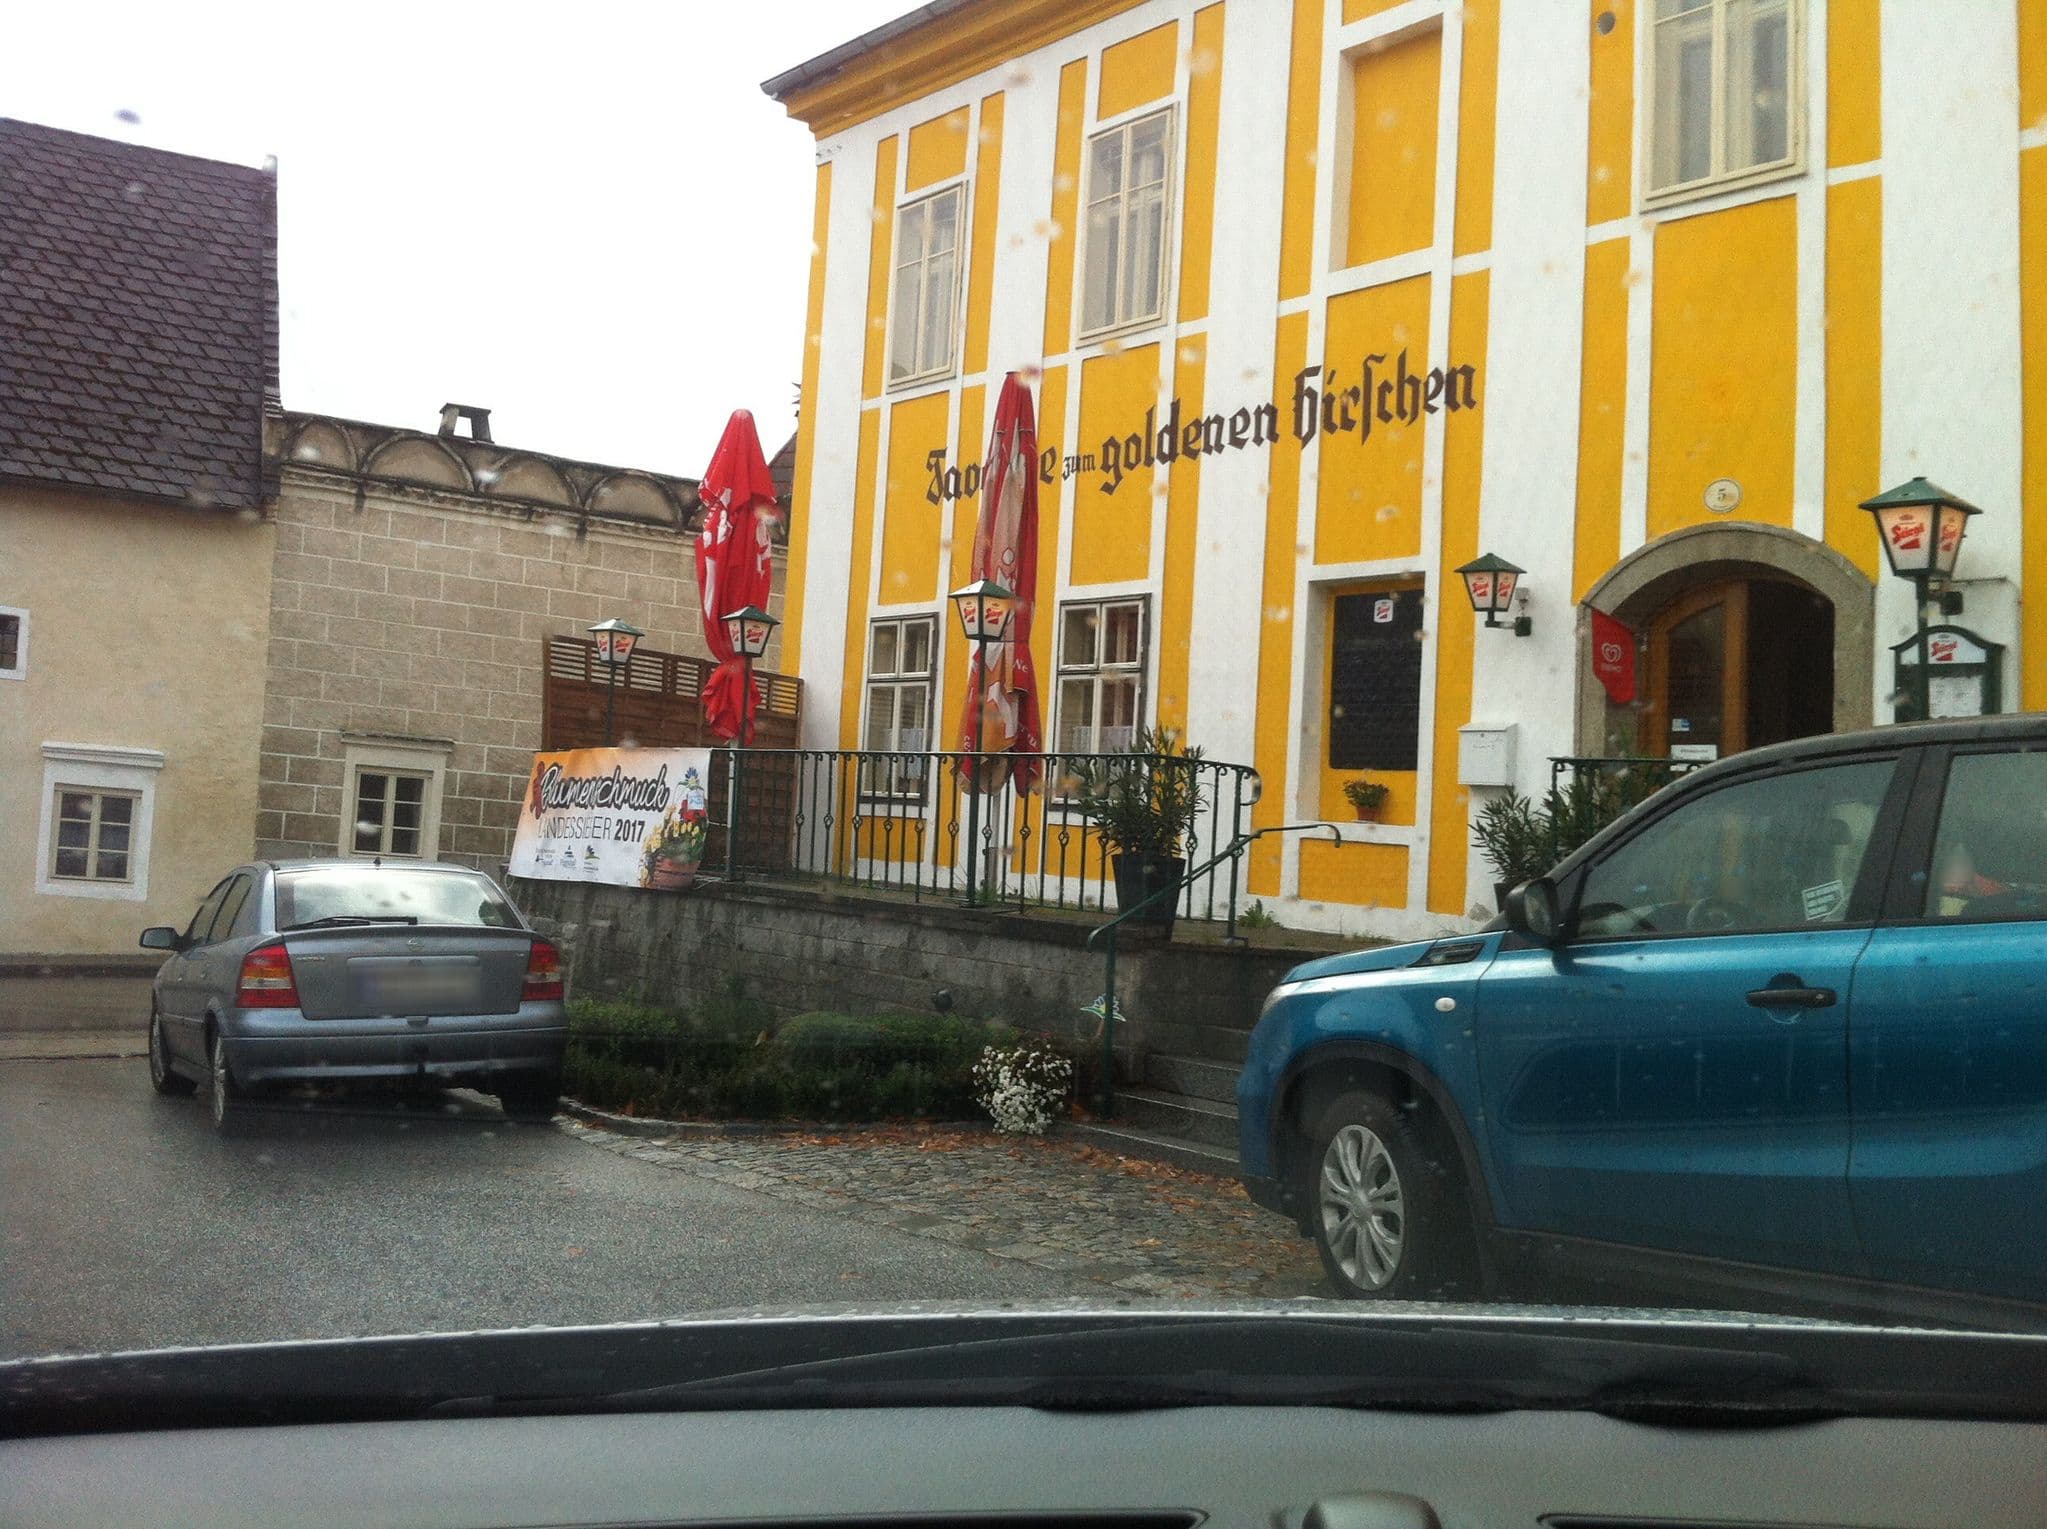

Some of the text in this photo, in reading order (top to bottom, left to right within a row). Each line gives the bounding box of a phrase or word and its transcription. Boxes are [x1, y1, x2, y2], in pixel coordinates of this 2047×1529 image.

[1062, 453, 1096, 481] zum
[1100, 398, 1280, 496] goldenen
[1717, 487, 1727, 502] 5
[614, 818, 646, 843] 2017
